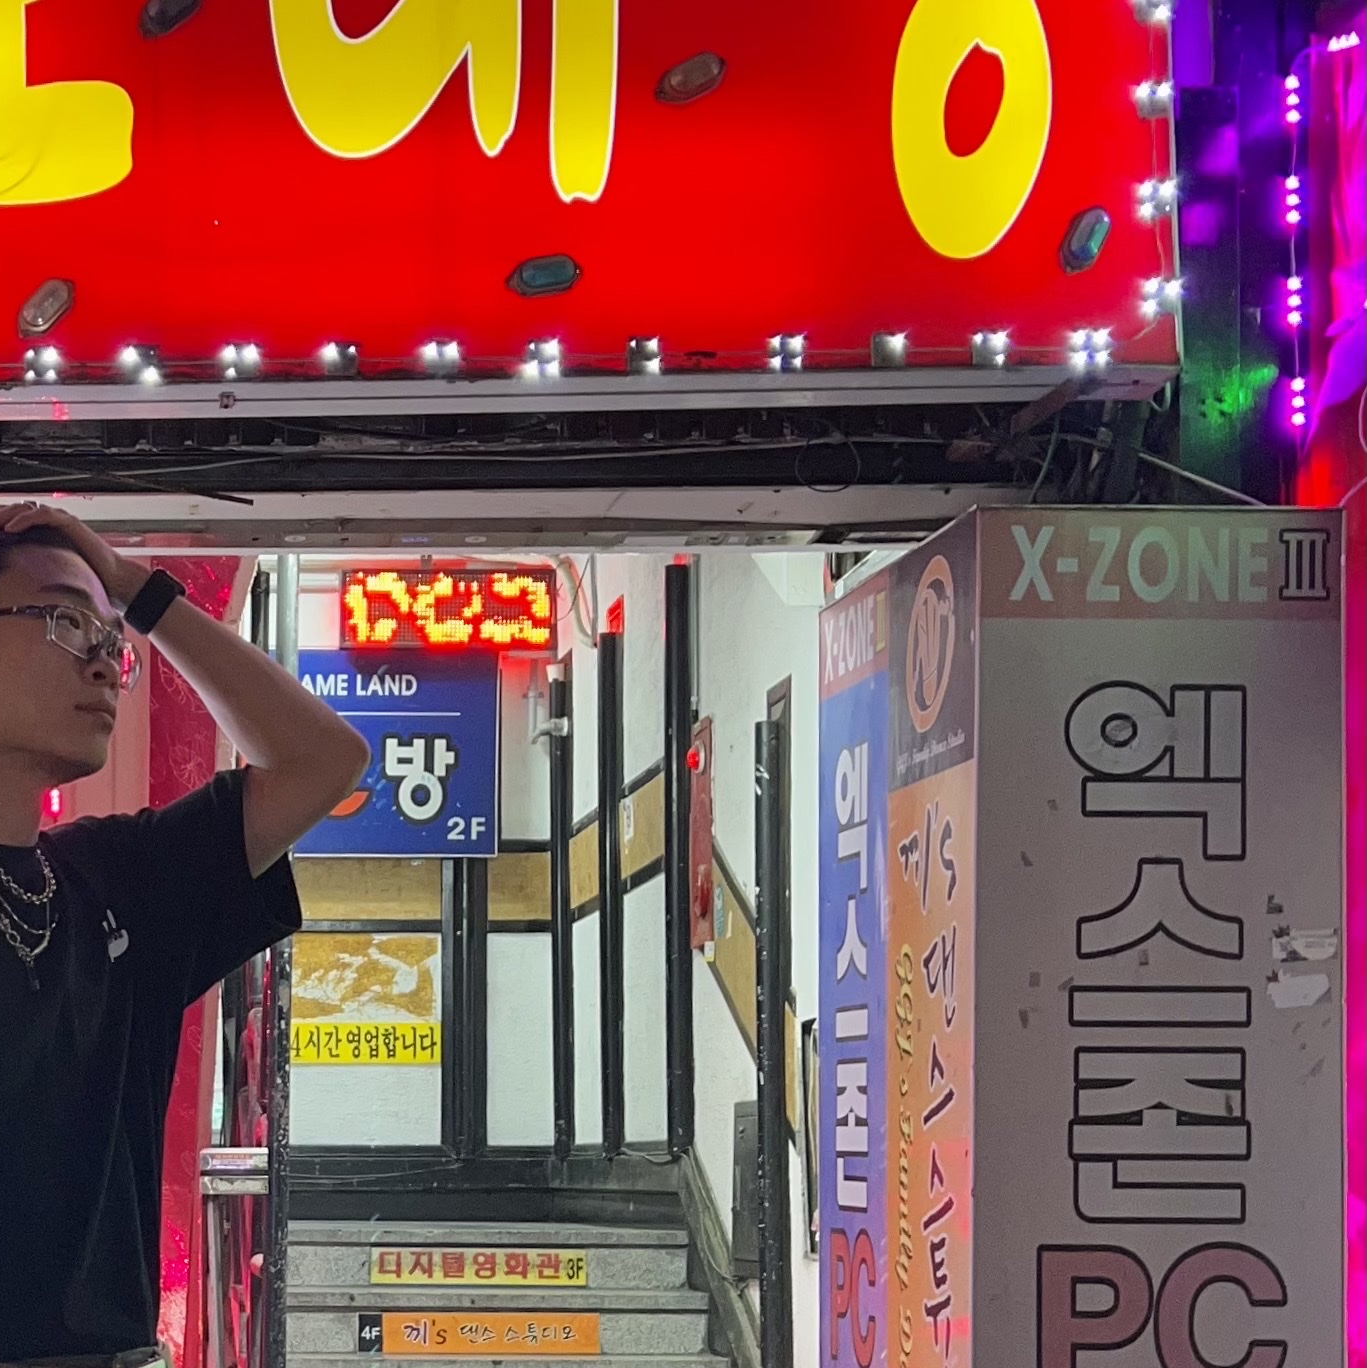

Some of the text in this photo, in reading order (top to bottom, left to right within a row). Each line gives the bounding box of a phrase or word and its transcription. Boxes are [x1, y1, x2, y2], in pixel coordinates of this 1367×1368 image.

[1008, 524, 1269, 602] X-ZONE
[824, 593, 875, 685] X-ZONE
[355, 673, 418, 697] LAND
[446, 816, 487, 841] 2F
[377, 1251, 584, 1281] 디지털영화관 3F
[360, 1325, 382, 1341] 4F
